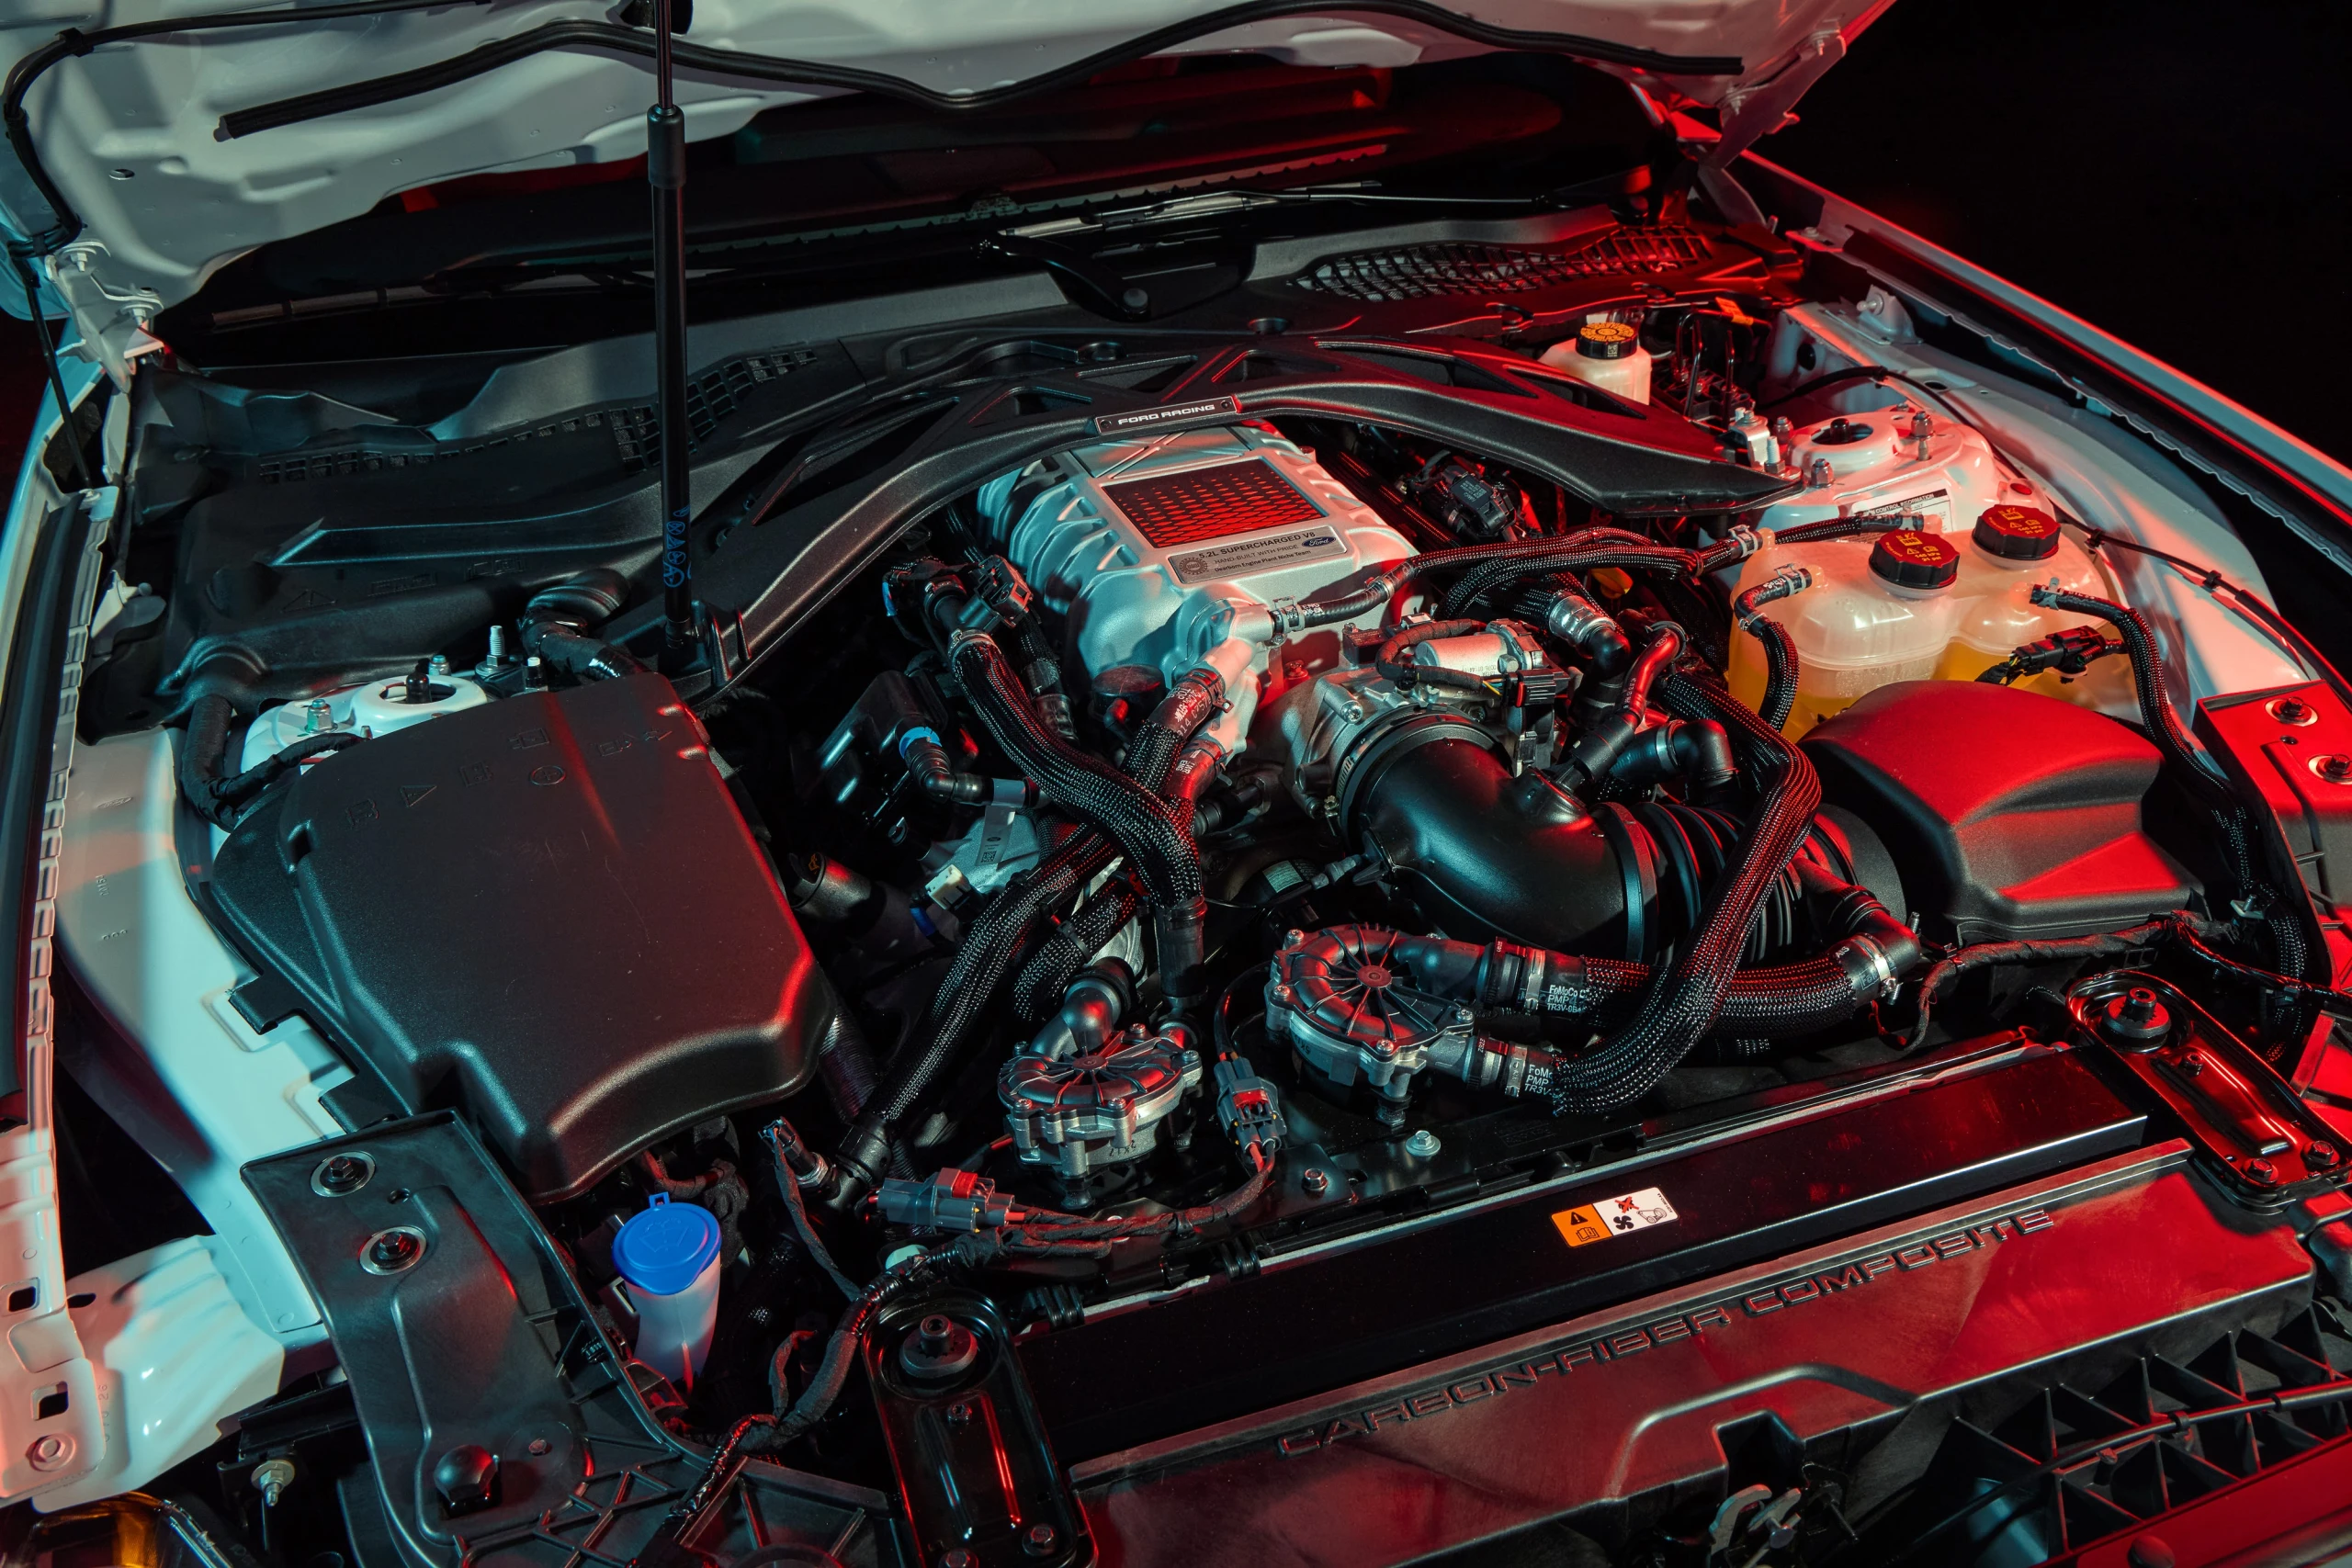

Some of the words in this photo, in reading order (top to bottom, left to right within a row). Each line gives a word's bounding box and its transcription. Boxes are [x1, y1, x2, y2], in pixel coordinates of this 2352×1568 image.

[1117, 413, 1159, 425] FORD
[1160, 404, 1215, 418] RACING
[1875, 502, 1900, 514] CONTROL
[1198, 548, 1219, 559] 5.2L
[1220, 535, 1302, 556] SUPERCHARGED
[1214, 552, 1257, 565] HAND-BUILT
[1257, 548, 1276, 557] WITH
[1276, 544, 1299, 553] PRIDE
[1214, 562, 1241, 573] Dearborn
[1241, 558, 1261, 570] Engine
[1261, 555, 1279, 565] Plant
[1279, 552, 1295, 561] Niche
[1295, 549, 1312, 558] Team
[1178, 687, 1192, 700] TOP
[1547, 994, 1570, 1004] PMP
[1549, 984, 1578, 998] FoMoCo
[1526, 1075, 1549, 1086] PMP
[1276, 1306, 1732, 1458] CARBON-FIBER
[1743, 1207, 2055, 1318] COMPOSITE
